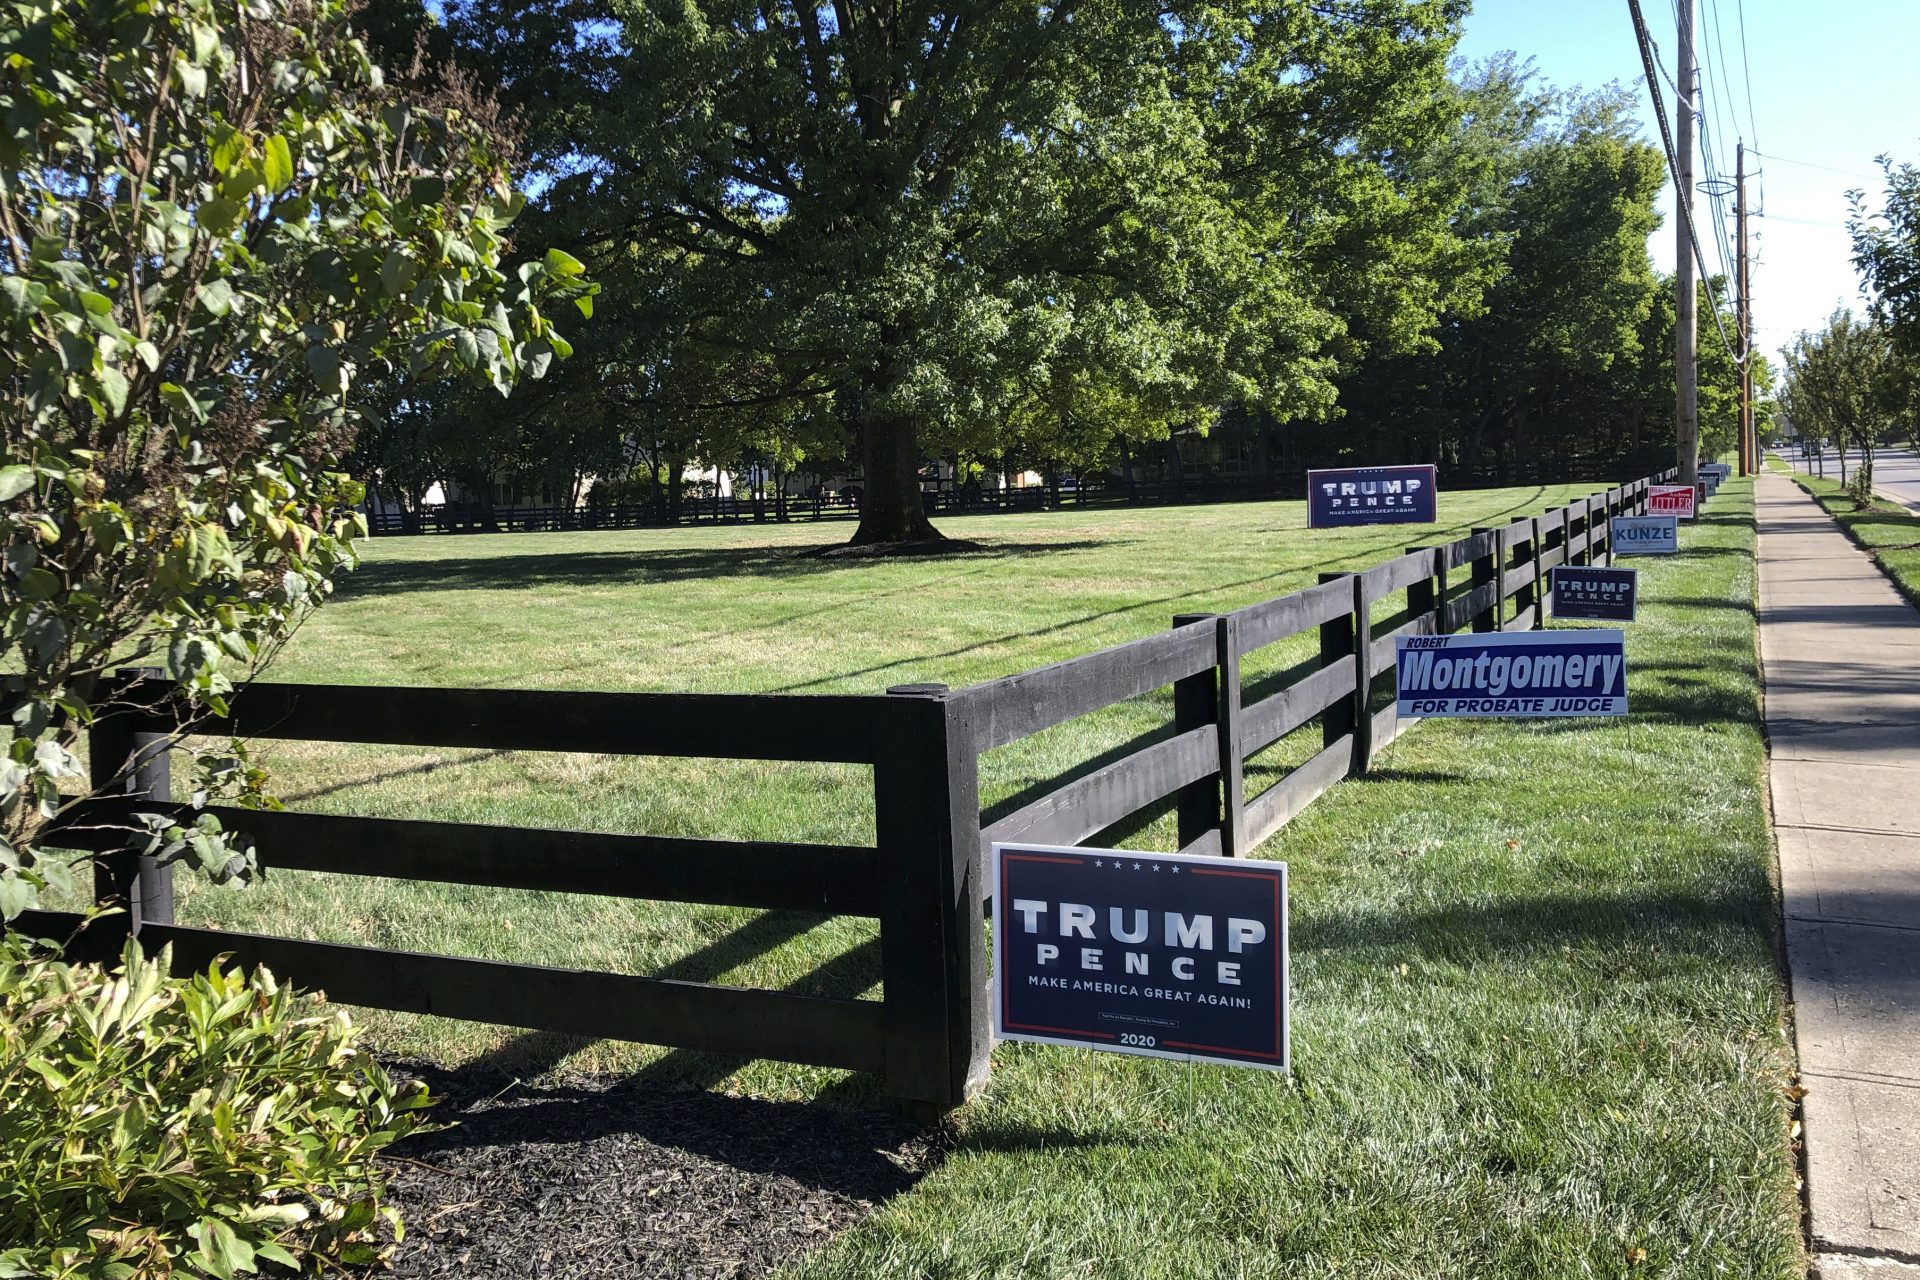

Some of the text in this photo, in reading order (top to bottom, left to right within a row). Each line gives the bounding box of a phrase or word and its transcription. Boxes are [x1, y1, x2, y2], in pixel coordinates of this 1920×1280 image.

[1322, 480, 1421, 496] TRUMP
[1332, 496, 1412, 507] PENCE
[1650, 497, 1692, 509] LITTLER
[1616, 528, 1672, 540] KUNZE
[1558, 581, 1630, 592] TRUMP
[1564, 592, 1623, 600] PENCE
[1406, 637, 1450, 648] ROBERT
[1400, 650, 1622, 696] Montgomery
[1411, 698, 1613, 713] FOR PROBATE JUDGE
[1013, 898, 1266, 954] TRUMP
[1037, 944, 1241, 985] PENCE
[1029, 976, 1251, 1009] MAKE AMERICA GREAT AGAIN!
[1121, 1032, 1155, 1047] 2020
